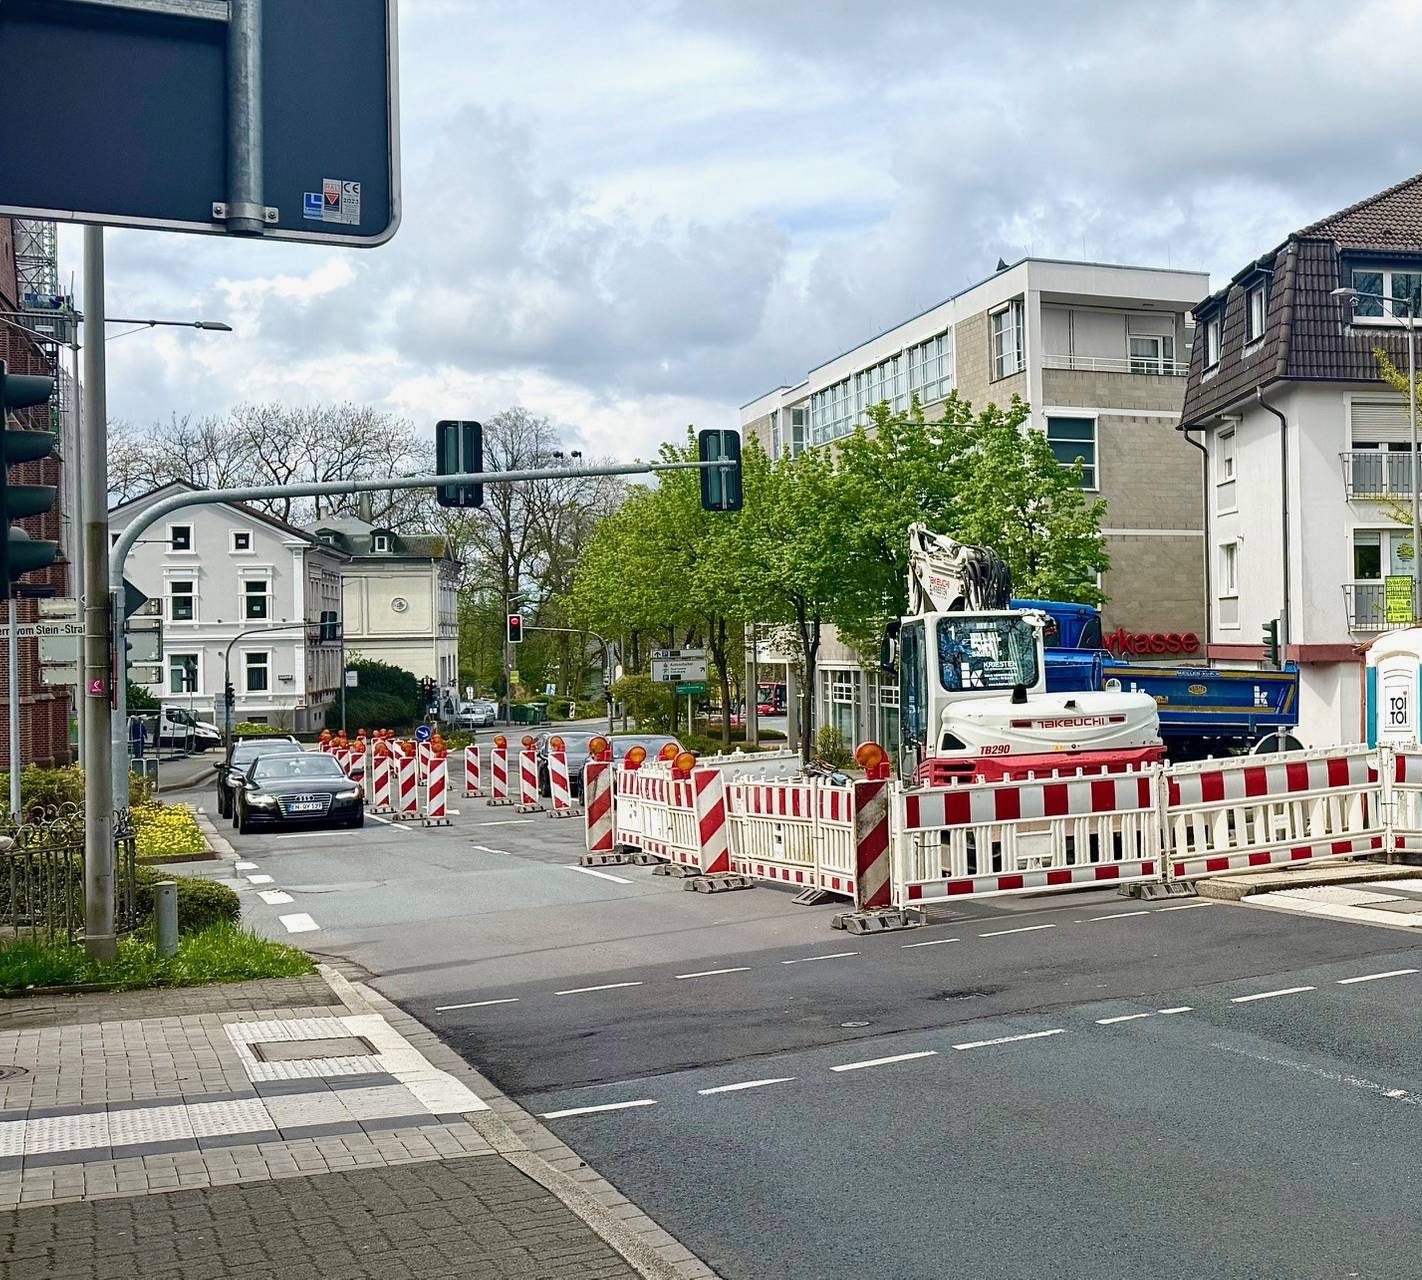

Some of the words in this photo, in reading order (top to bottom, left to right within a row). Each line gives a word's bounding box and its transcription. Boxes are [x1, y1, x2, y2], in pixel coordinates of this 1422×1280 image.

[343, 183, 360, 194] CE
[36, 625, 58, 635] Stein
[1390, 696, 1407, 711] TOI
[1037, 716, 1105, 729] TAKEUCHI
[1390, 710, 1407, 725] TOI
[980, 744, 1011, 756] TB290
